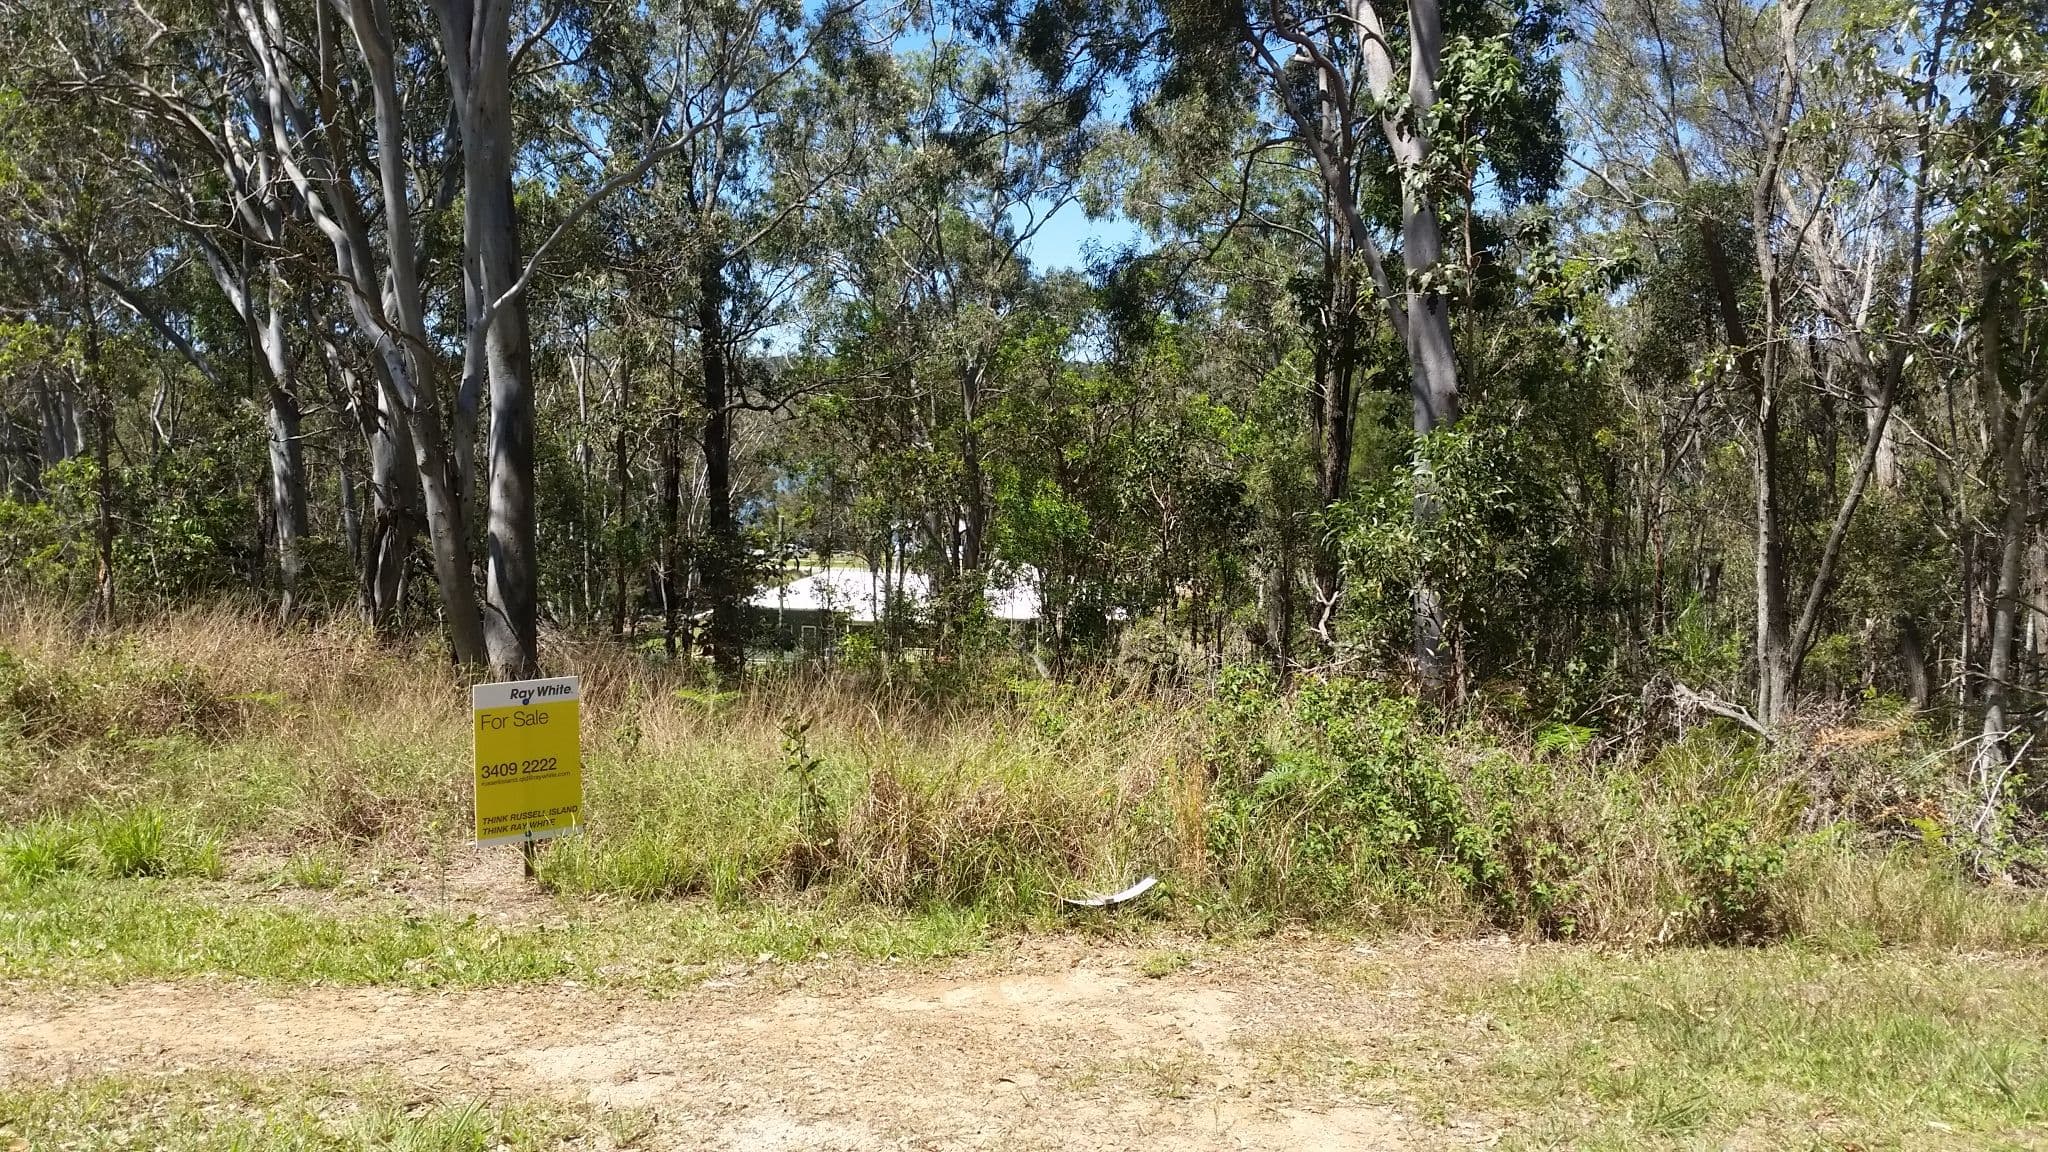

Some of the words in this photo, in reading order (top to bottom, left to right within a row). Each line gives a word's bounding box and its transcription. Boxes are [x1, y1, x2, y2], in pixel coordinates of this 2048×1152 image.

[510, 688, 535, 700] Ray
[537, 684, 572, 697] White
[481, 714, 508, 730] For
[513, 709, 549, 727] Sale
[481, 762, 517, 779] 3409
[522, 757, 557, 774] 2222
[483, 814, 508, 825] THINK
[510, 810, 546, 821] RUSSELL
[549, 805, 578, 816] ISLAND
[483, 825, 508, 835] THINK
[510, 822, 528, 832] RAY
[529, 818, 556, 829] WHITE
